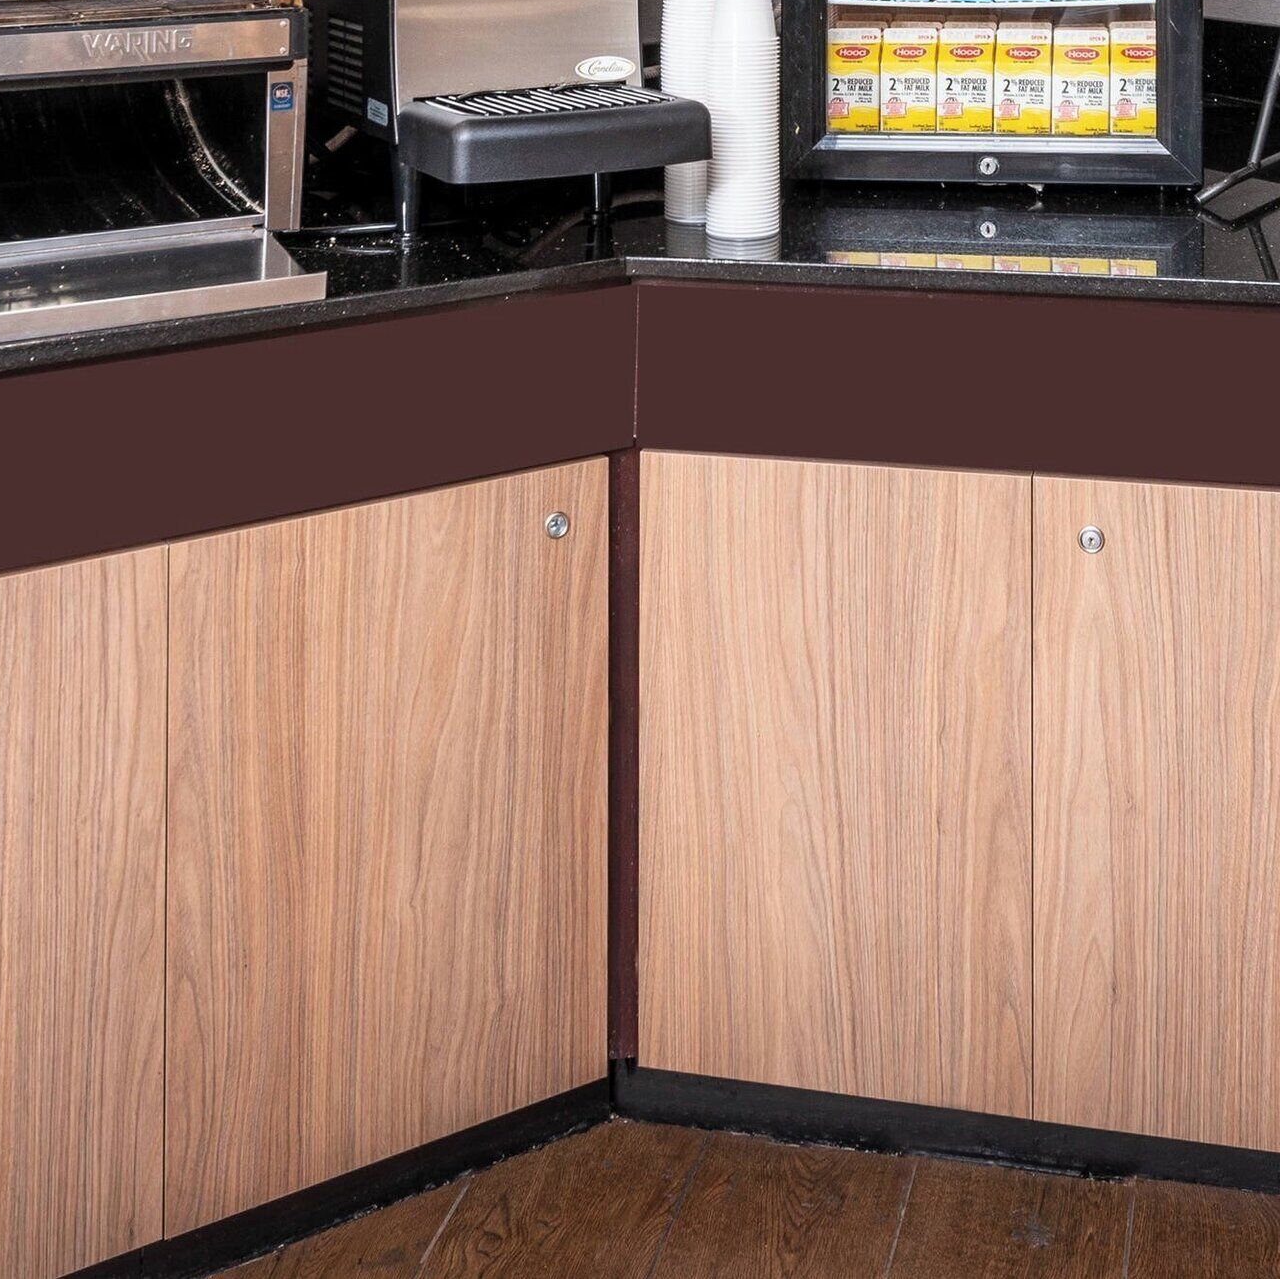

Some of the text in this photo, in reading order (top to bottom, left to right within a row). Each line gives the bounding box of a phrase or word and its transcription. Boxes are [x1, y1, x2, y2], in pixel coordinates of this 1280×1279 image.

[81, 29, 194, 61] WARING
[840, 48, 867, 56] Hood
[1009, 49, 1037, 57] Hood
[832, 77, 847, 91] 2%
[889, 77, 903, 91] 2%
[946, 77, 960, 91] 2%
[1003, 79, 1018, 92] 2%
[1061, 80, 1076, 94] 2%
[1120, 78, 1134, 92] 2%
